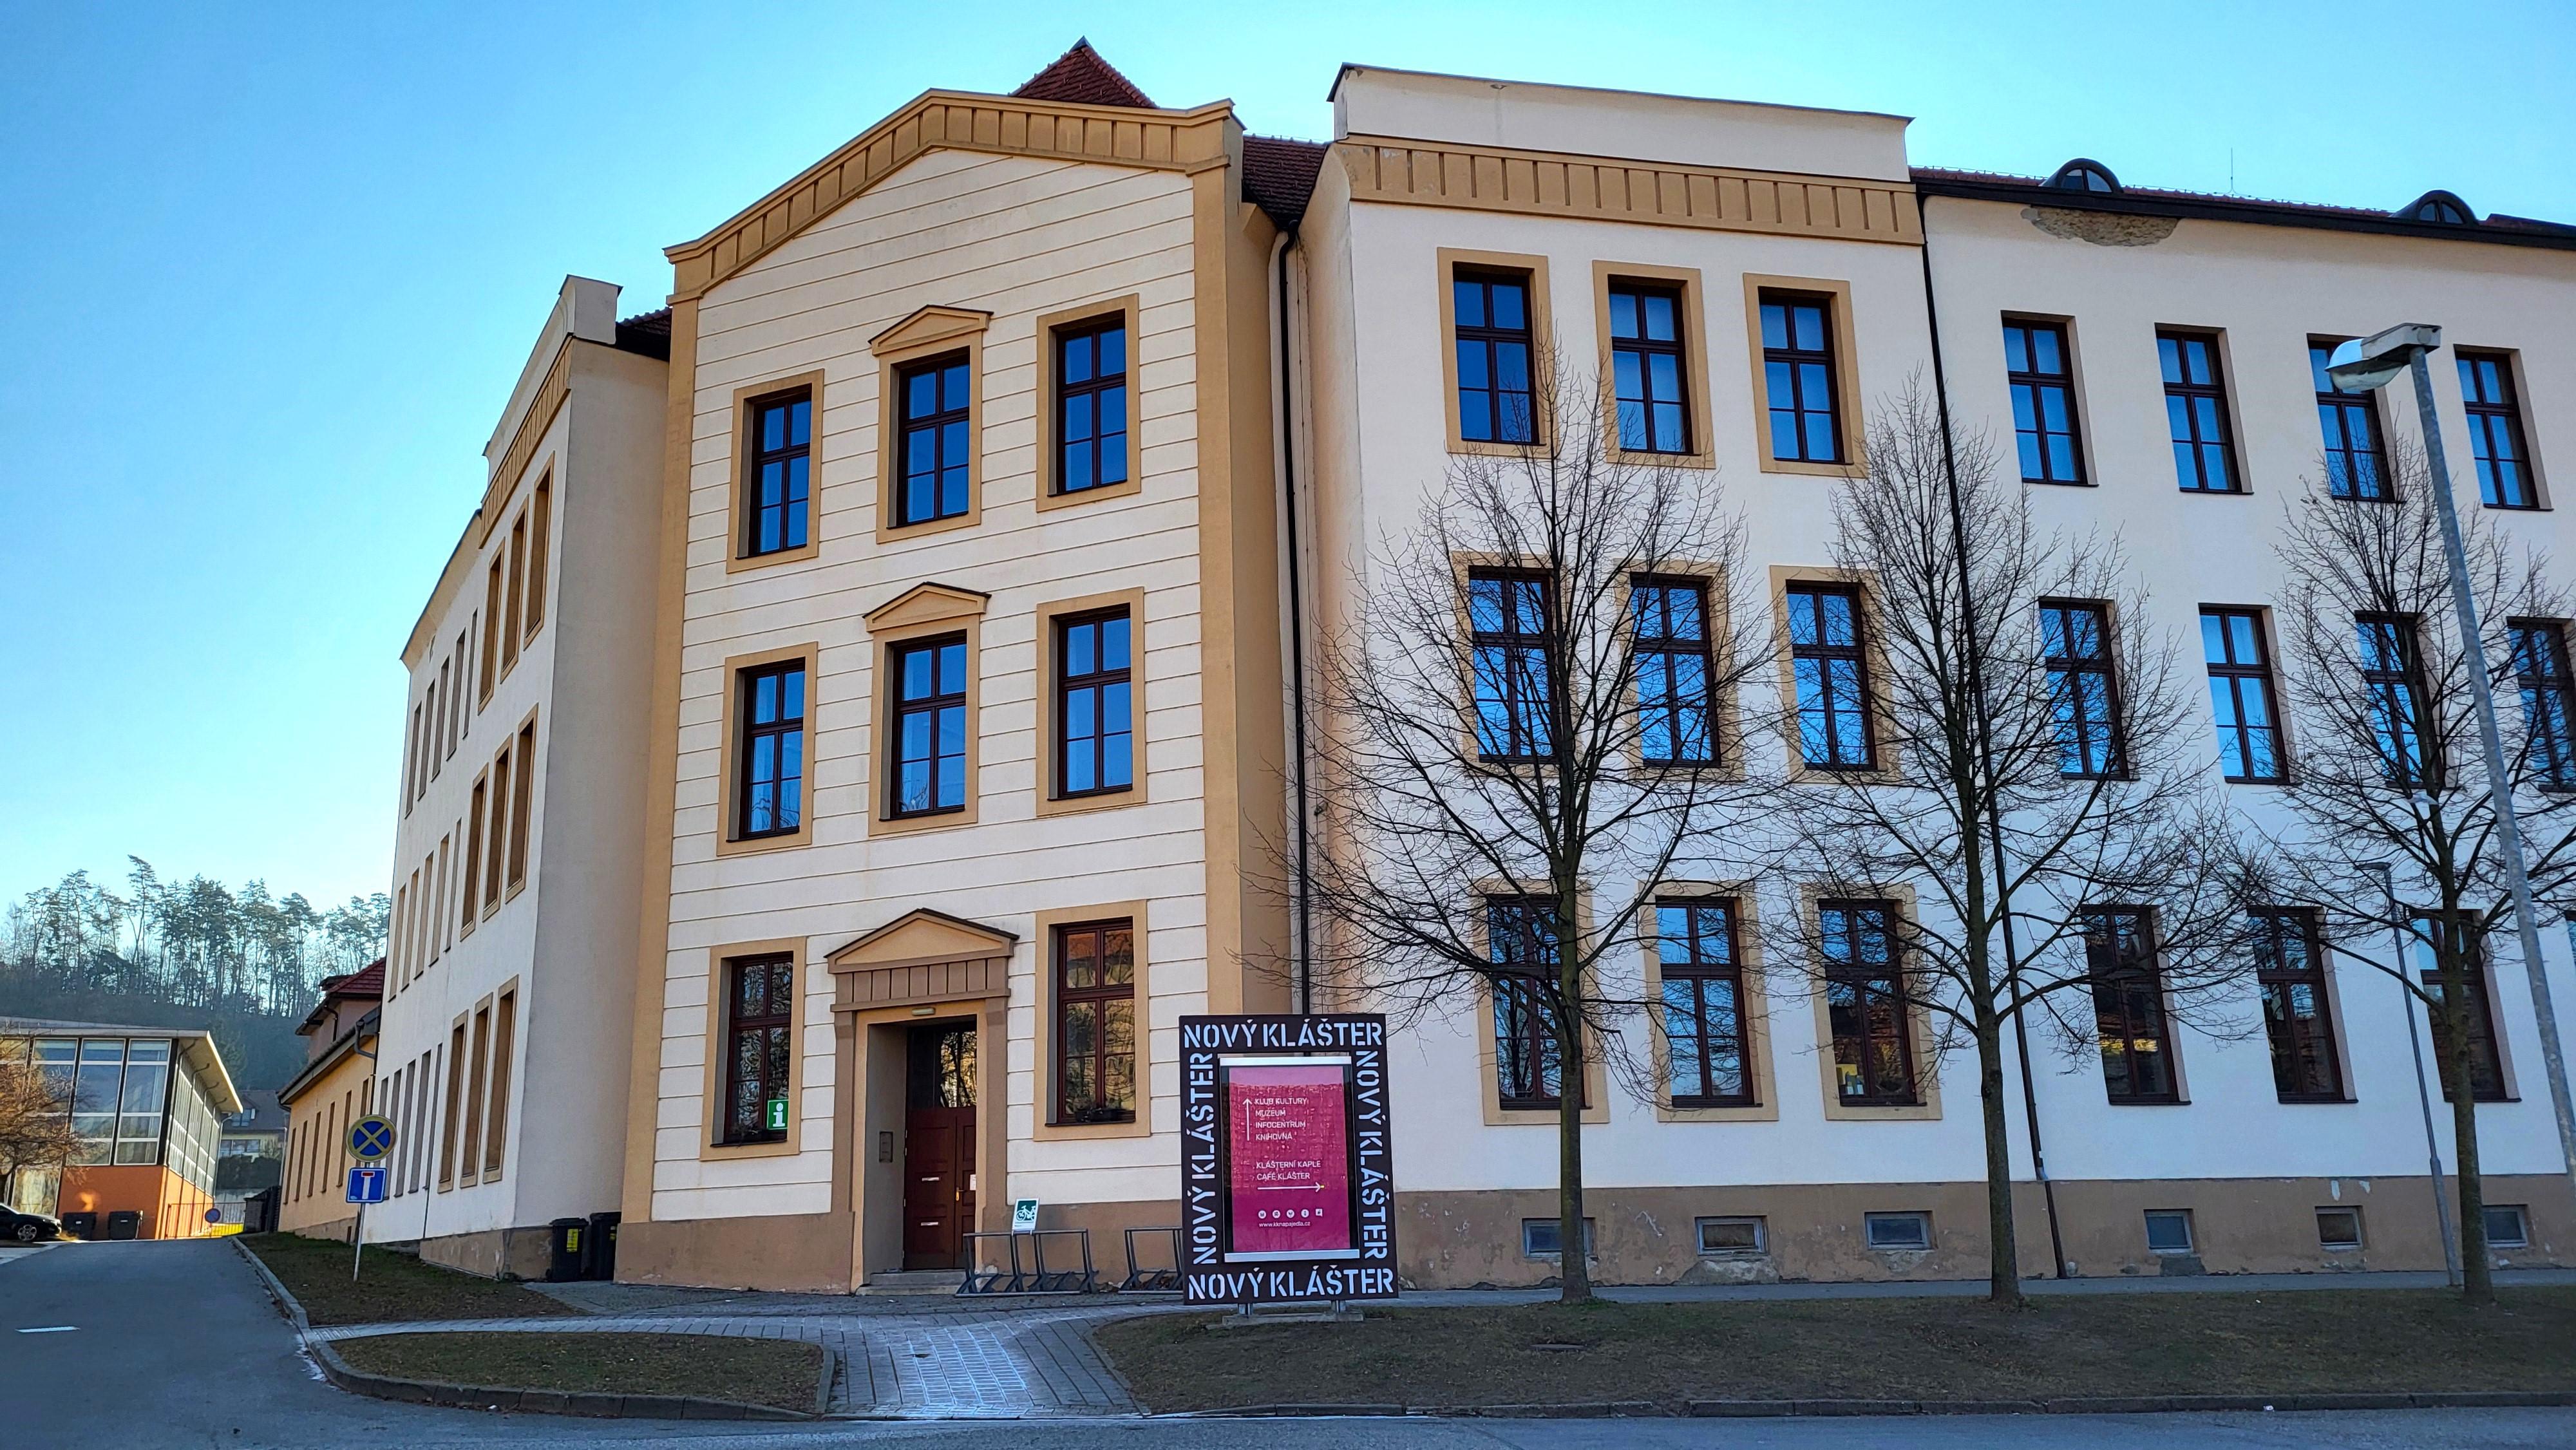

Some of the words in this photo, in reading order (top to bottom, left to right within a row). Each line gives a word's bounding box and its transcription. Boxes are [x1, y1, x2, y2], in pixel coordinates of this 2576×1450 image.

[1184, 1019, 1257, 1048] NOVÝ
[1263, 1018, 1382, 1047] KLÁŠTER
[1356, 1050, 1386, 1125] NOVÝ
[1186, 1053, 1215, 1179] KLÁŠTER
[1256, 1133, 1293, 1141] KNIHOVNA
[1256, 1160, 1296, 1169] KLÁŠTERNÍ
[1256, 1171, 1276, 1180] CAFÉ
[1277, 1171, 1311, 1180] KLÁŠTER
[1359, 1131, 1390, 1259] KLÁŠTER
[1187, 1185, 1217, 1265] NOVÝ
[1188, 1267, 1264, 1299] NOVÝ
[1270, 1265, 1394, 1297] KLÁŠTER
